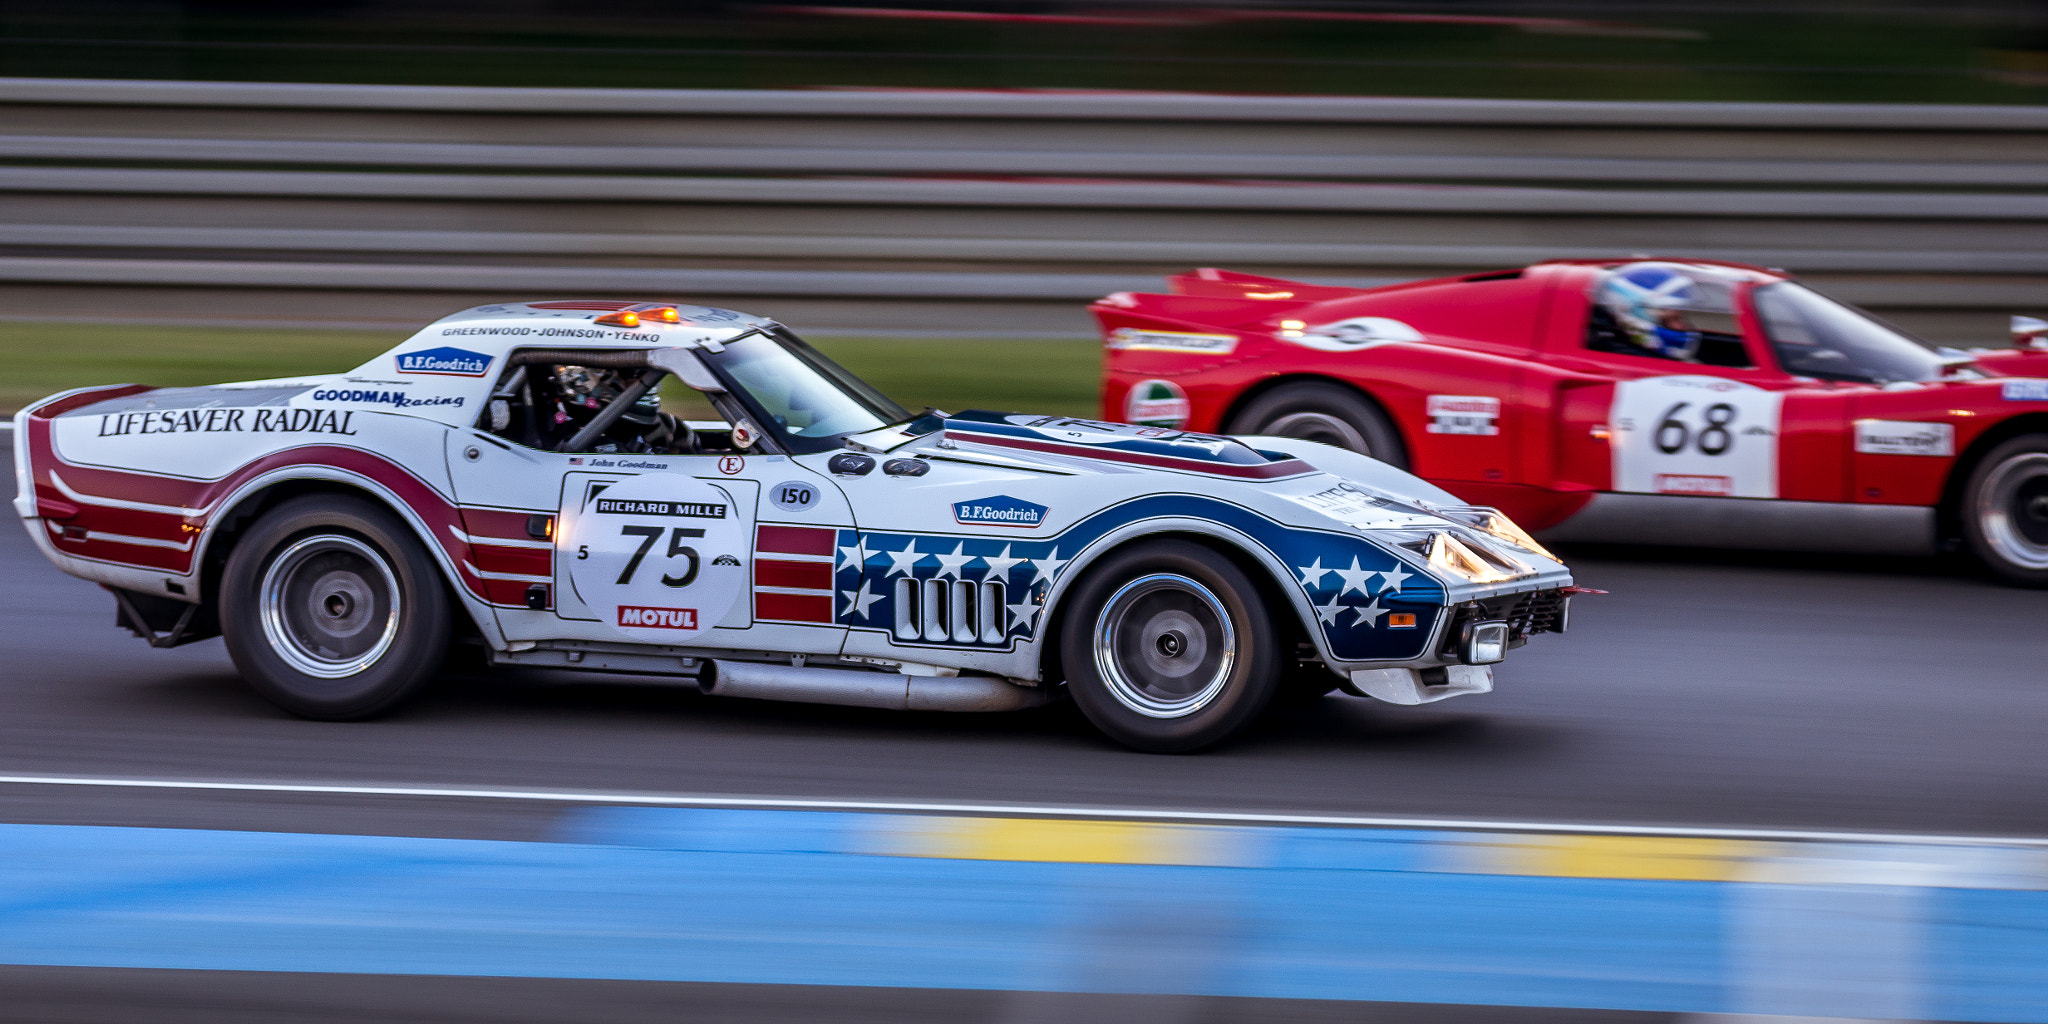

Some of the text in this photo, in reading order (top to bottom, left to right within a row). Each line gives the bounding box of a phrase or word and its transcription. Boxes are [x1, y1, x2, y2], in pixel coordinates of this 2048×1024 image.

[442, 327, 661, 343] GREENWOOD JOHNSON YENKO
[403, 356, 484, 371] B.F.Goodrich
[313, 390, 465, 408] GOODMAN Racing
[98, 408, 357, 437] LIFESAVER RADIAL
[1653, 401, 1737, 456] 68
[588, 458, 668, 470] John Goodman
[725, 458, 739, 471] E
[780, 487, 811, 505] 150
[599, 501, 724, 517] RICHARD MILLE
[960, 505, 1039, 522] B.F.Goodrich
[577, 545, 589, 560] 5
[615, 525, 706, 589] 75
[621, 609, 695, 627] MOTUL
